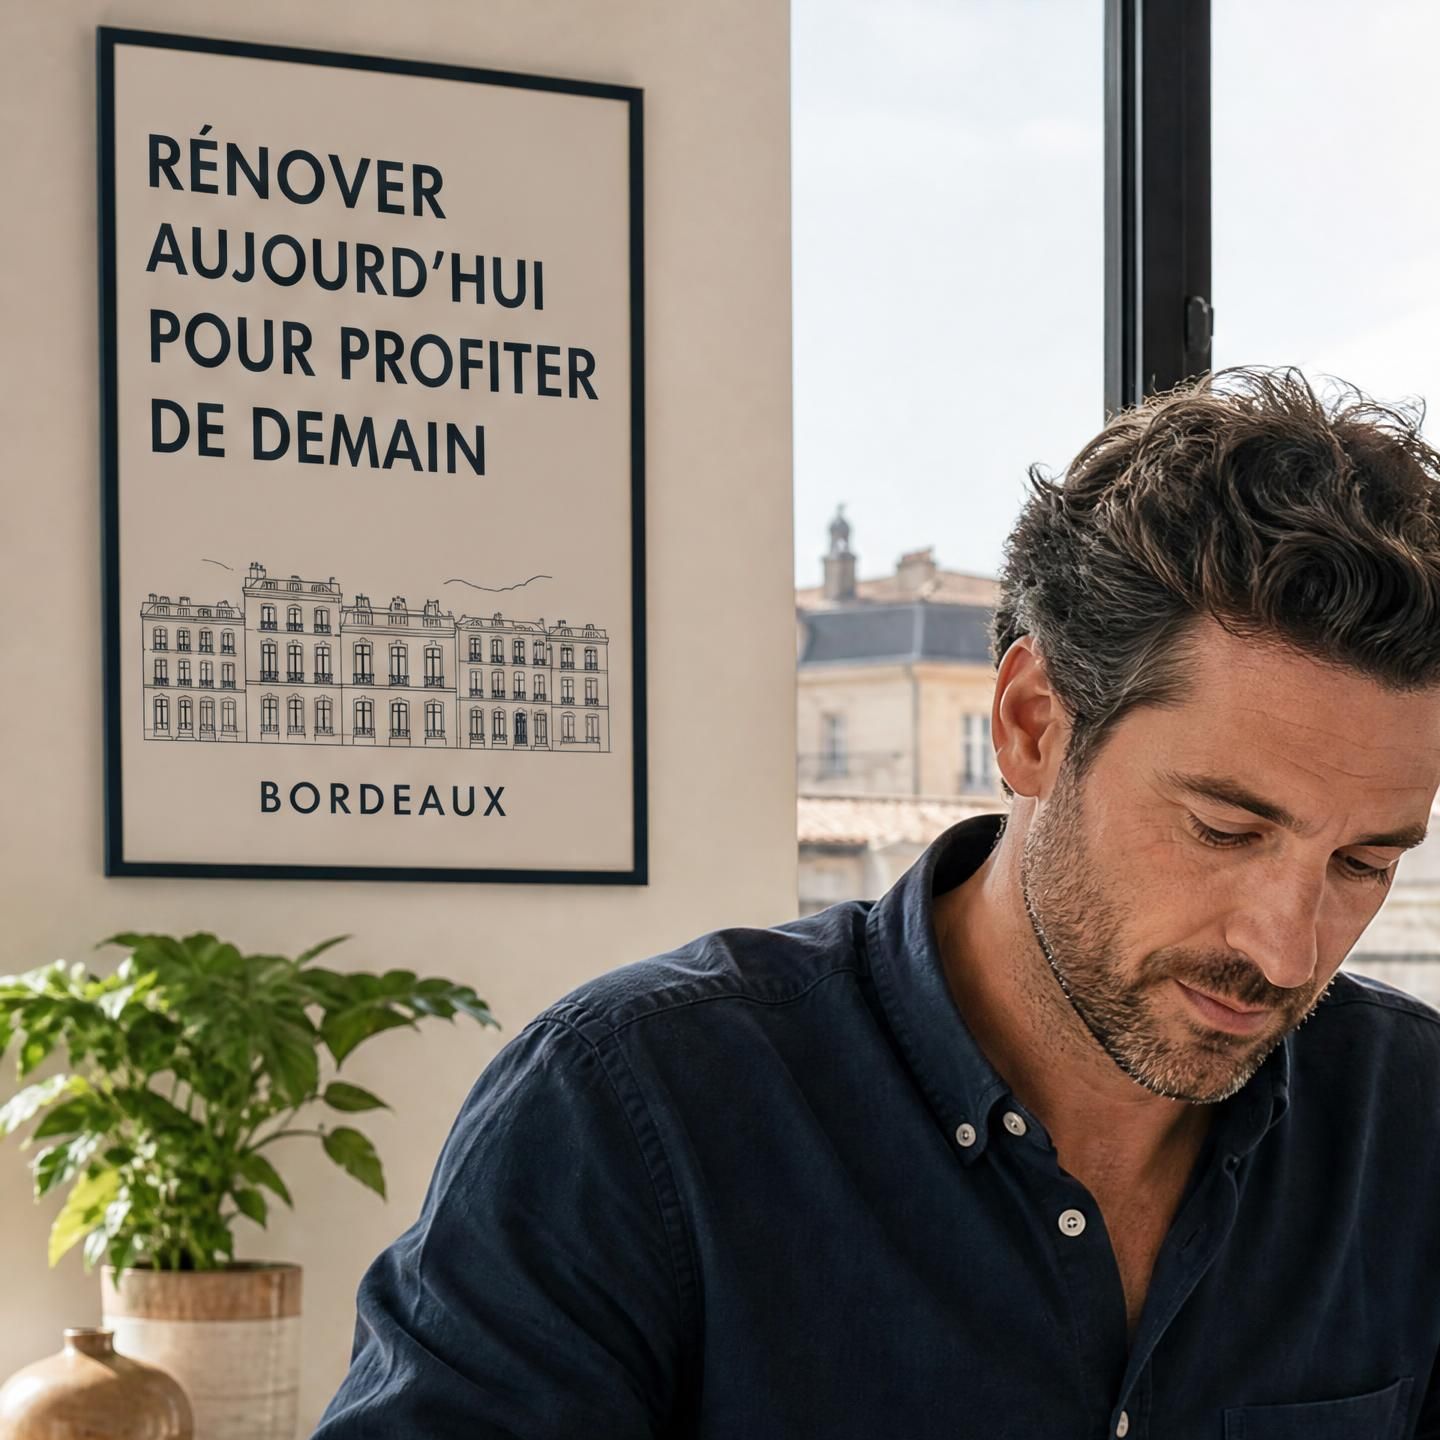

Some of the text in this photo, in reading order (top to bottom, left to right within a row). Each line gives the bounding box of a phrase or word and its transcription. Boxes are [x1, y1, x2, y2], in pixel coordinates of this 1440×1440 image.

[148, 124, 447, 220] RÉNOVER
[145, 222, 544, 311] AUJOURD'HUI
[149, 308, 599, 401] POUR PROFITER
[151, 398, 486, 476] DE DEMAIN
[260, 780, 507, 817] BORDEAUX
